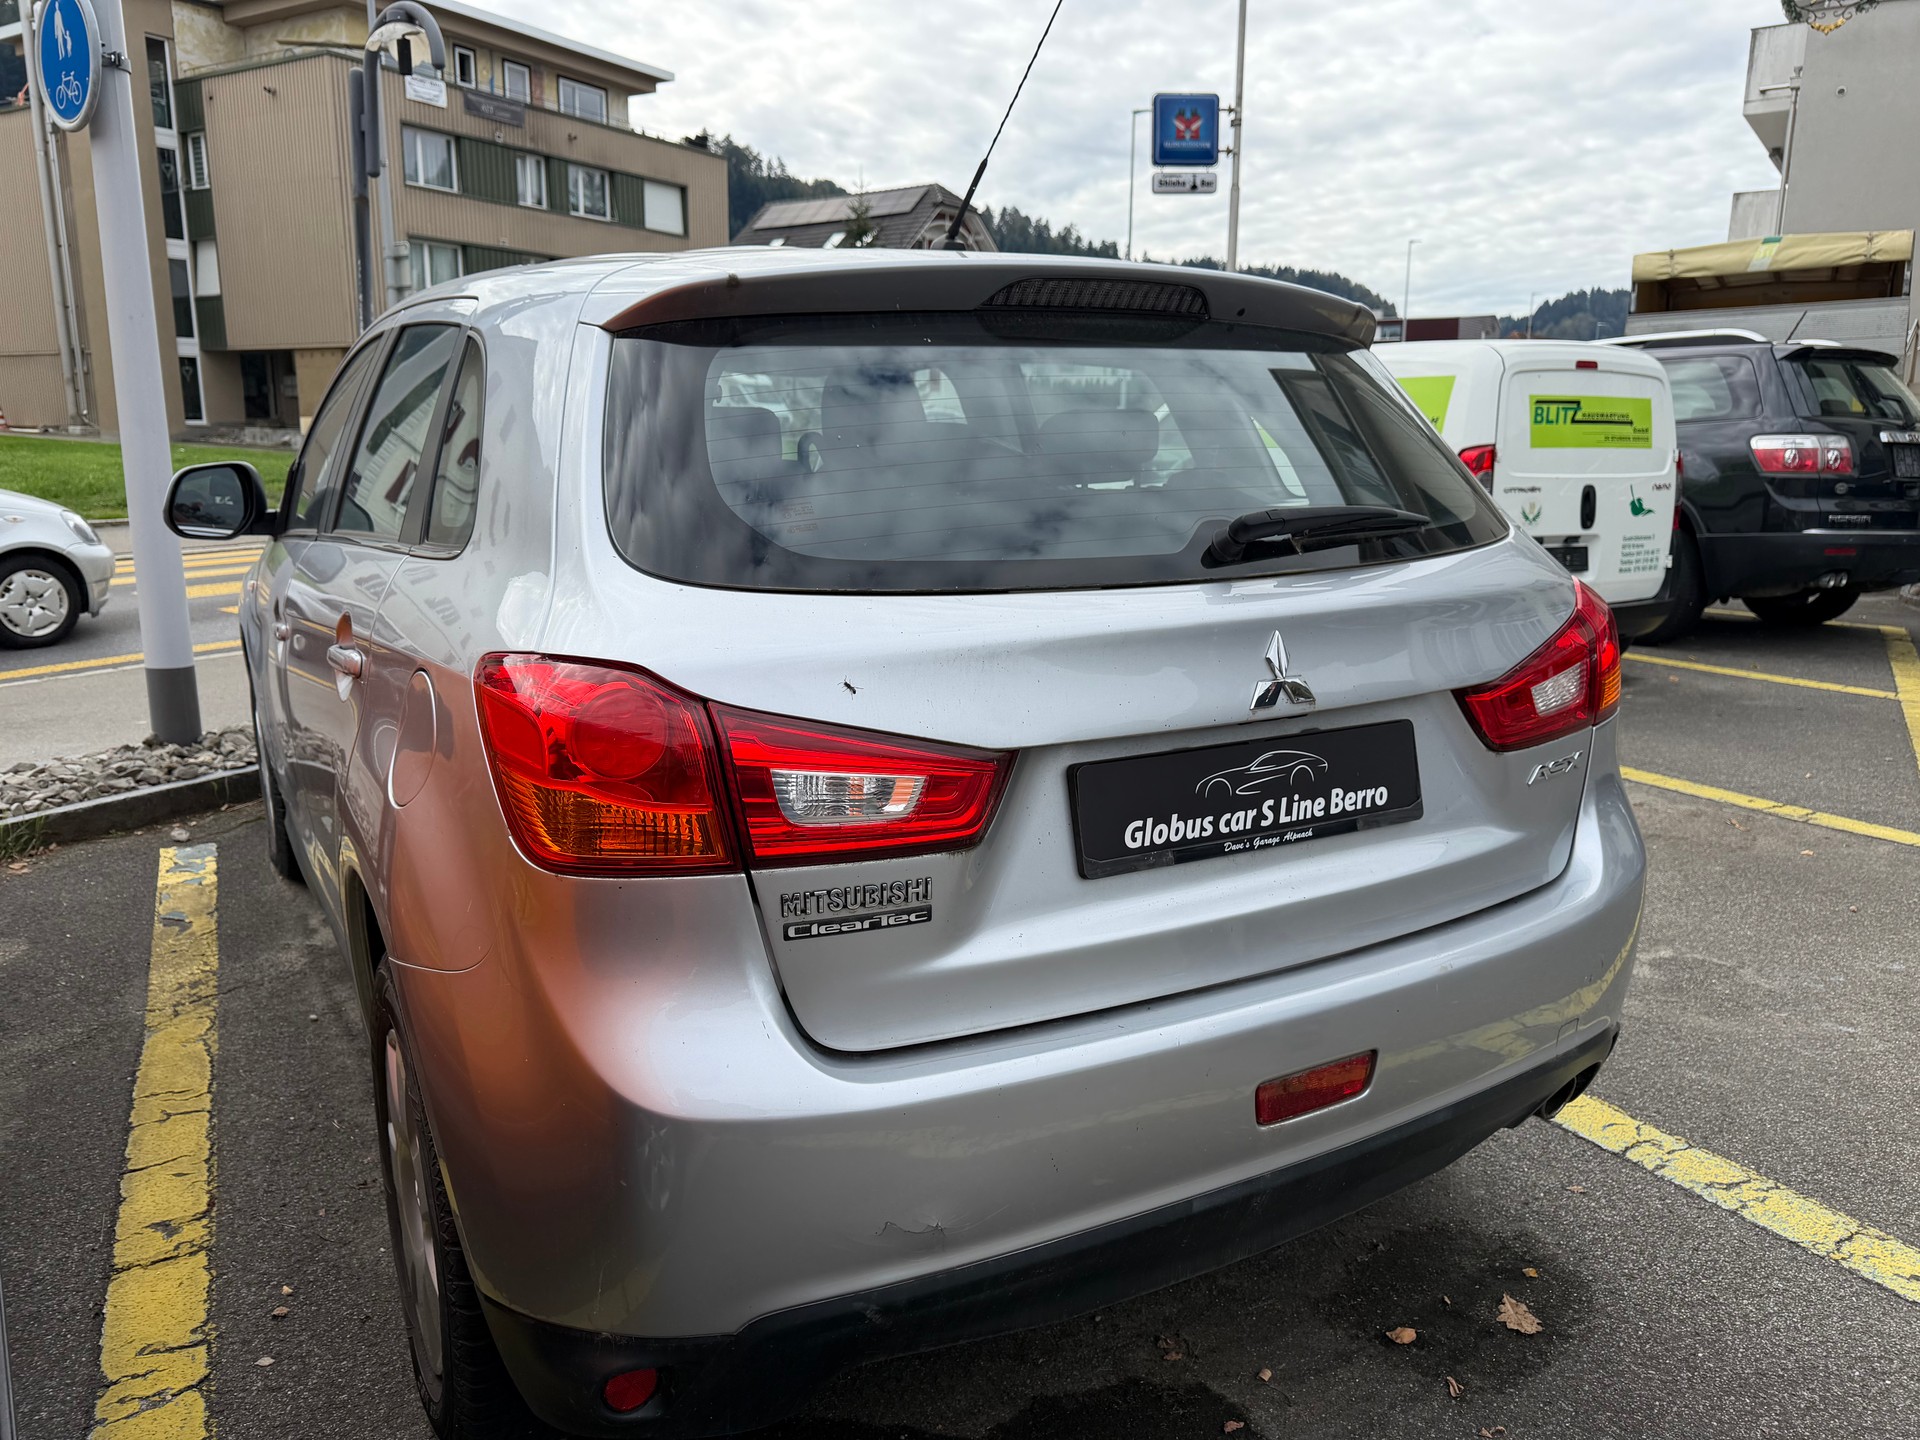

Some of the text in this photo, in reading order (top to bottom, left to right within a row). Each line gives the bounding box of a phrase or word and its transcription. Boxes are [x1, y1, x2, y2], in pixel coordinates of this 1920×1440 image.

[1533, 400, 1582, 425] BLITZ
[1124, 786, 1389, 849] Globus car S Line Berro
[1223, 828, 1314, 852] Dave's Garage Alpnach
[780, 876, 933, 918] MITSUBISHI
[787, 911, 929, 938] ClearTec
